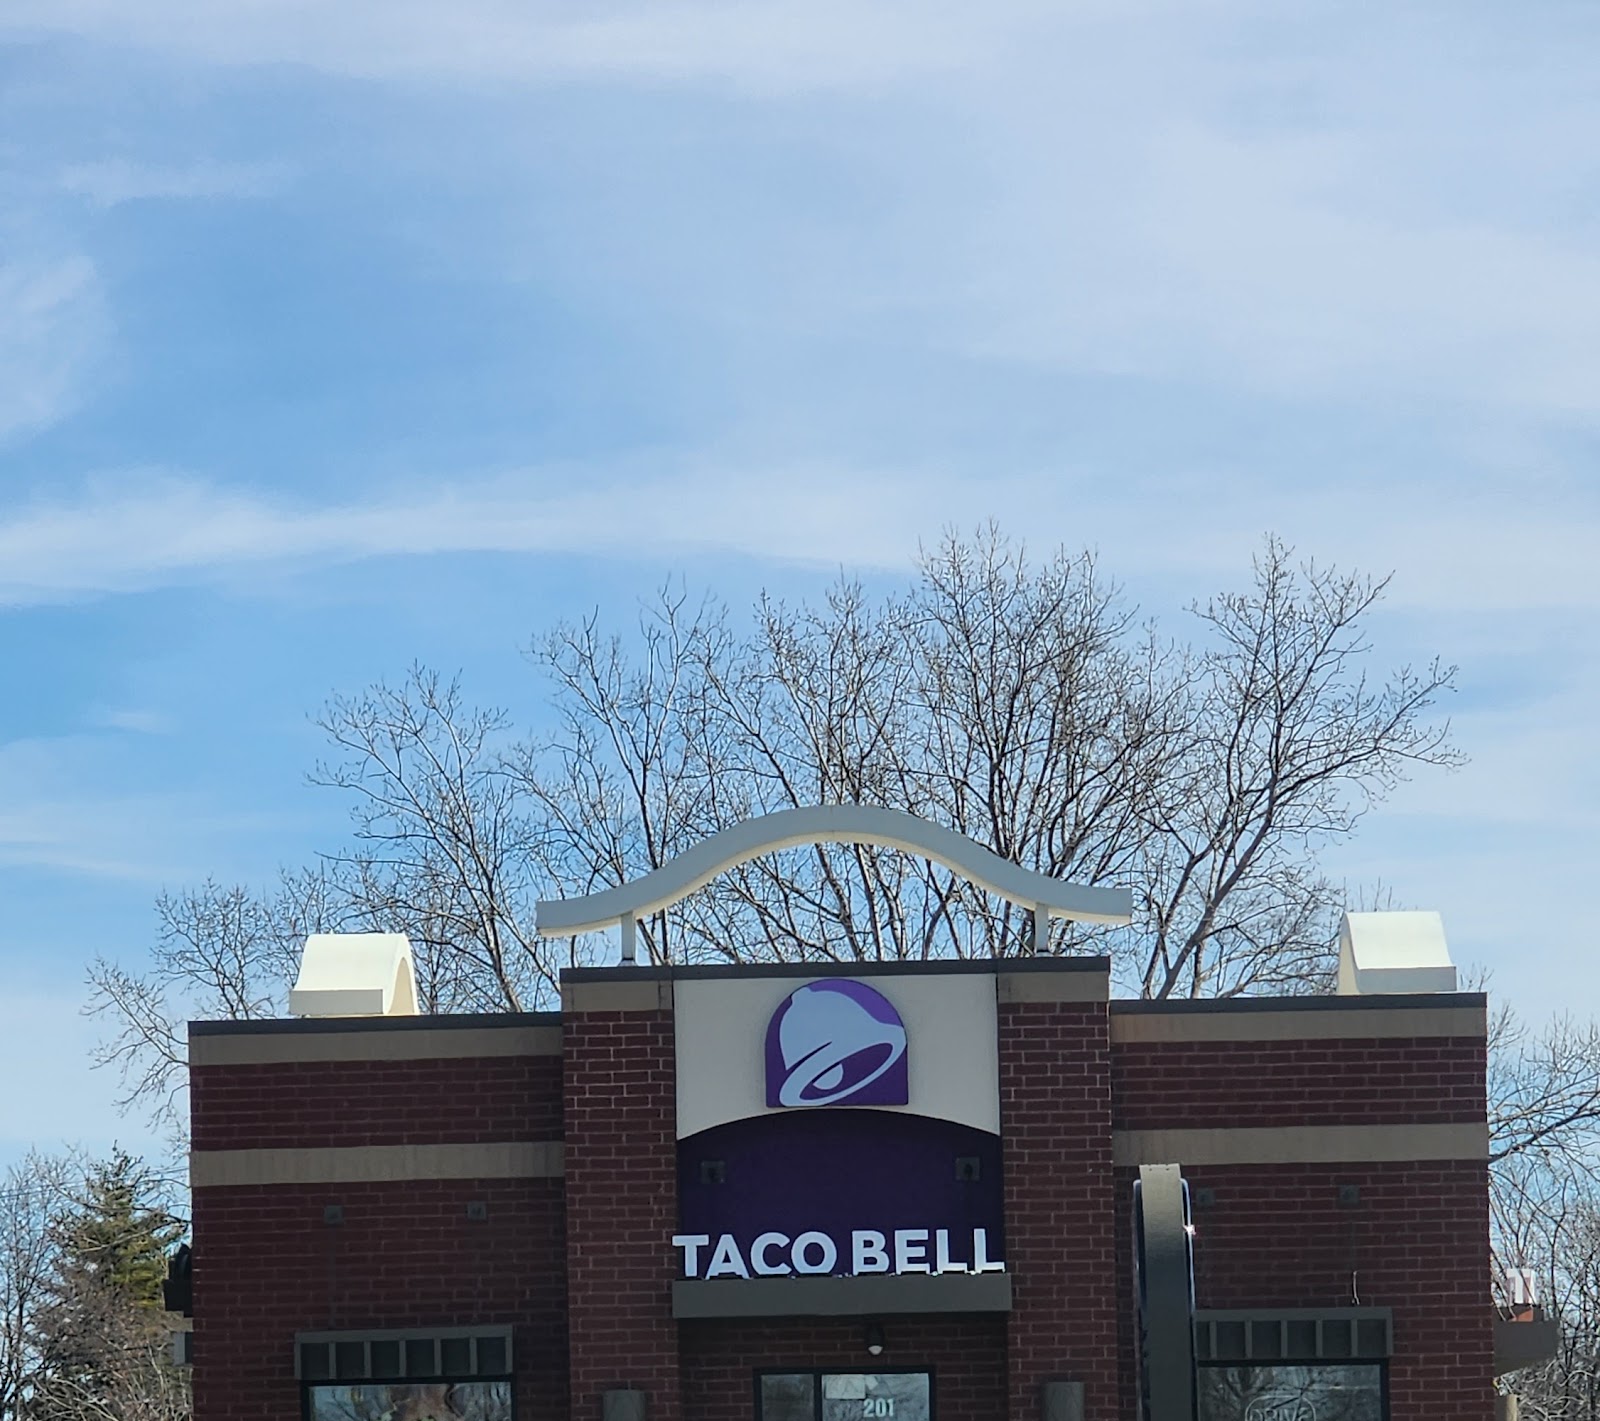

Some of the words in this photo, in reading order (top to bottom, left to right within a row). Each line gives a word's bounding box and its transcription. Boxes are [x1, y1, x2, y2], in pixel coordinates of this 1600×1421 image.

[671, 1230, 838, 1280] TACO
[851, 1228, 1006, 1276] BELL
[863, 1398, 894, 1418] 201
